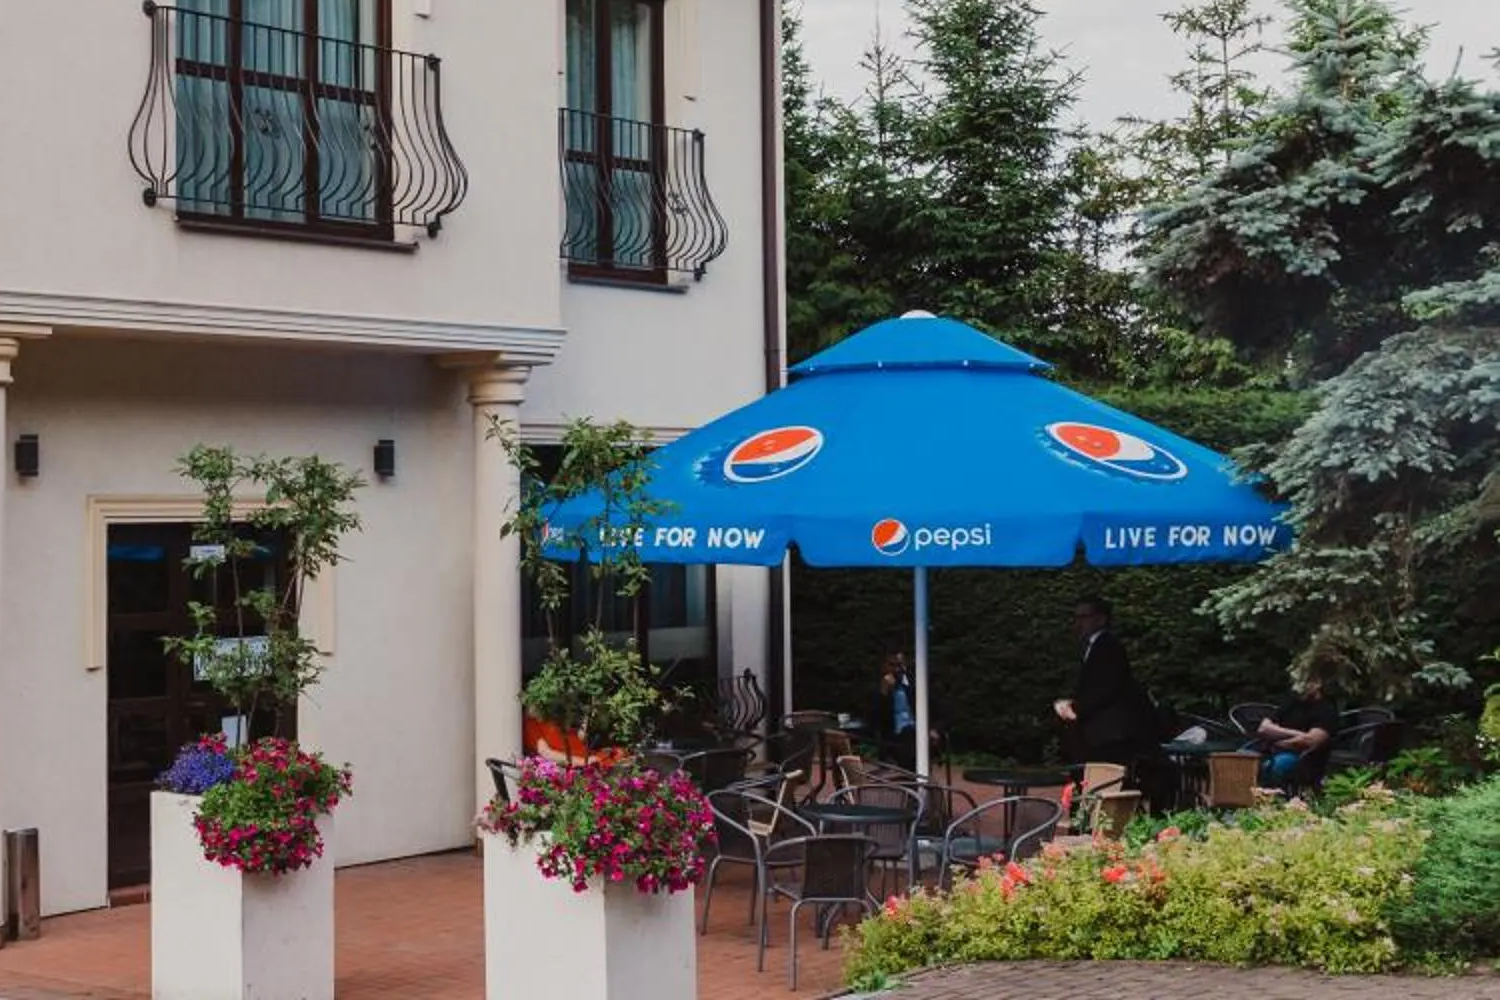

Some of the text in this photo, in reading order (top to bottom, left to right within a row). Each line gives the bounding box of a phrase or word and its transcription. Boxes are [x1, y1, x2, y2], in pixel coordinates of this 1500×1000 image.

[654, 527, 696, 548] FOR
[707, 527, 765, 549] NOW
[915, 523, 991, 551] pepsi
[1105, 525, 1277, 549] LIVE FOR NOW
